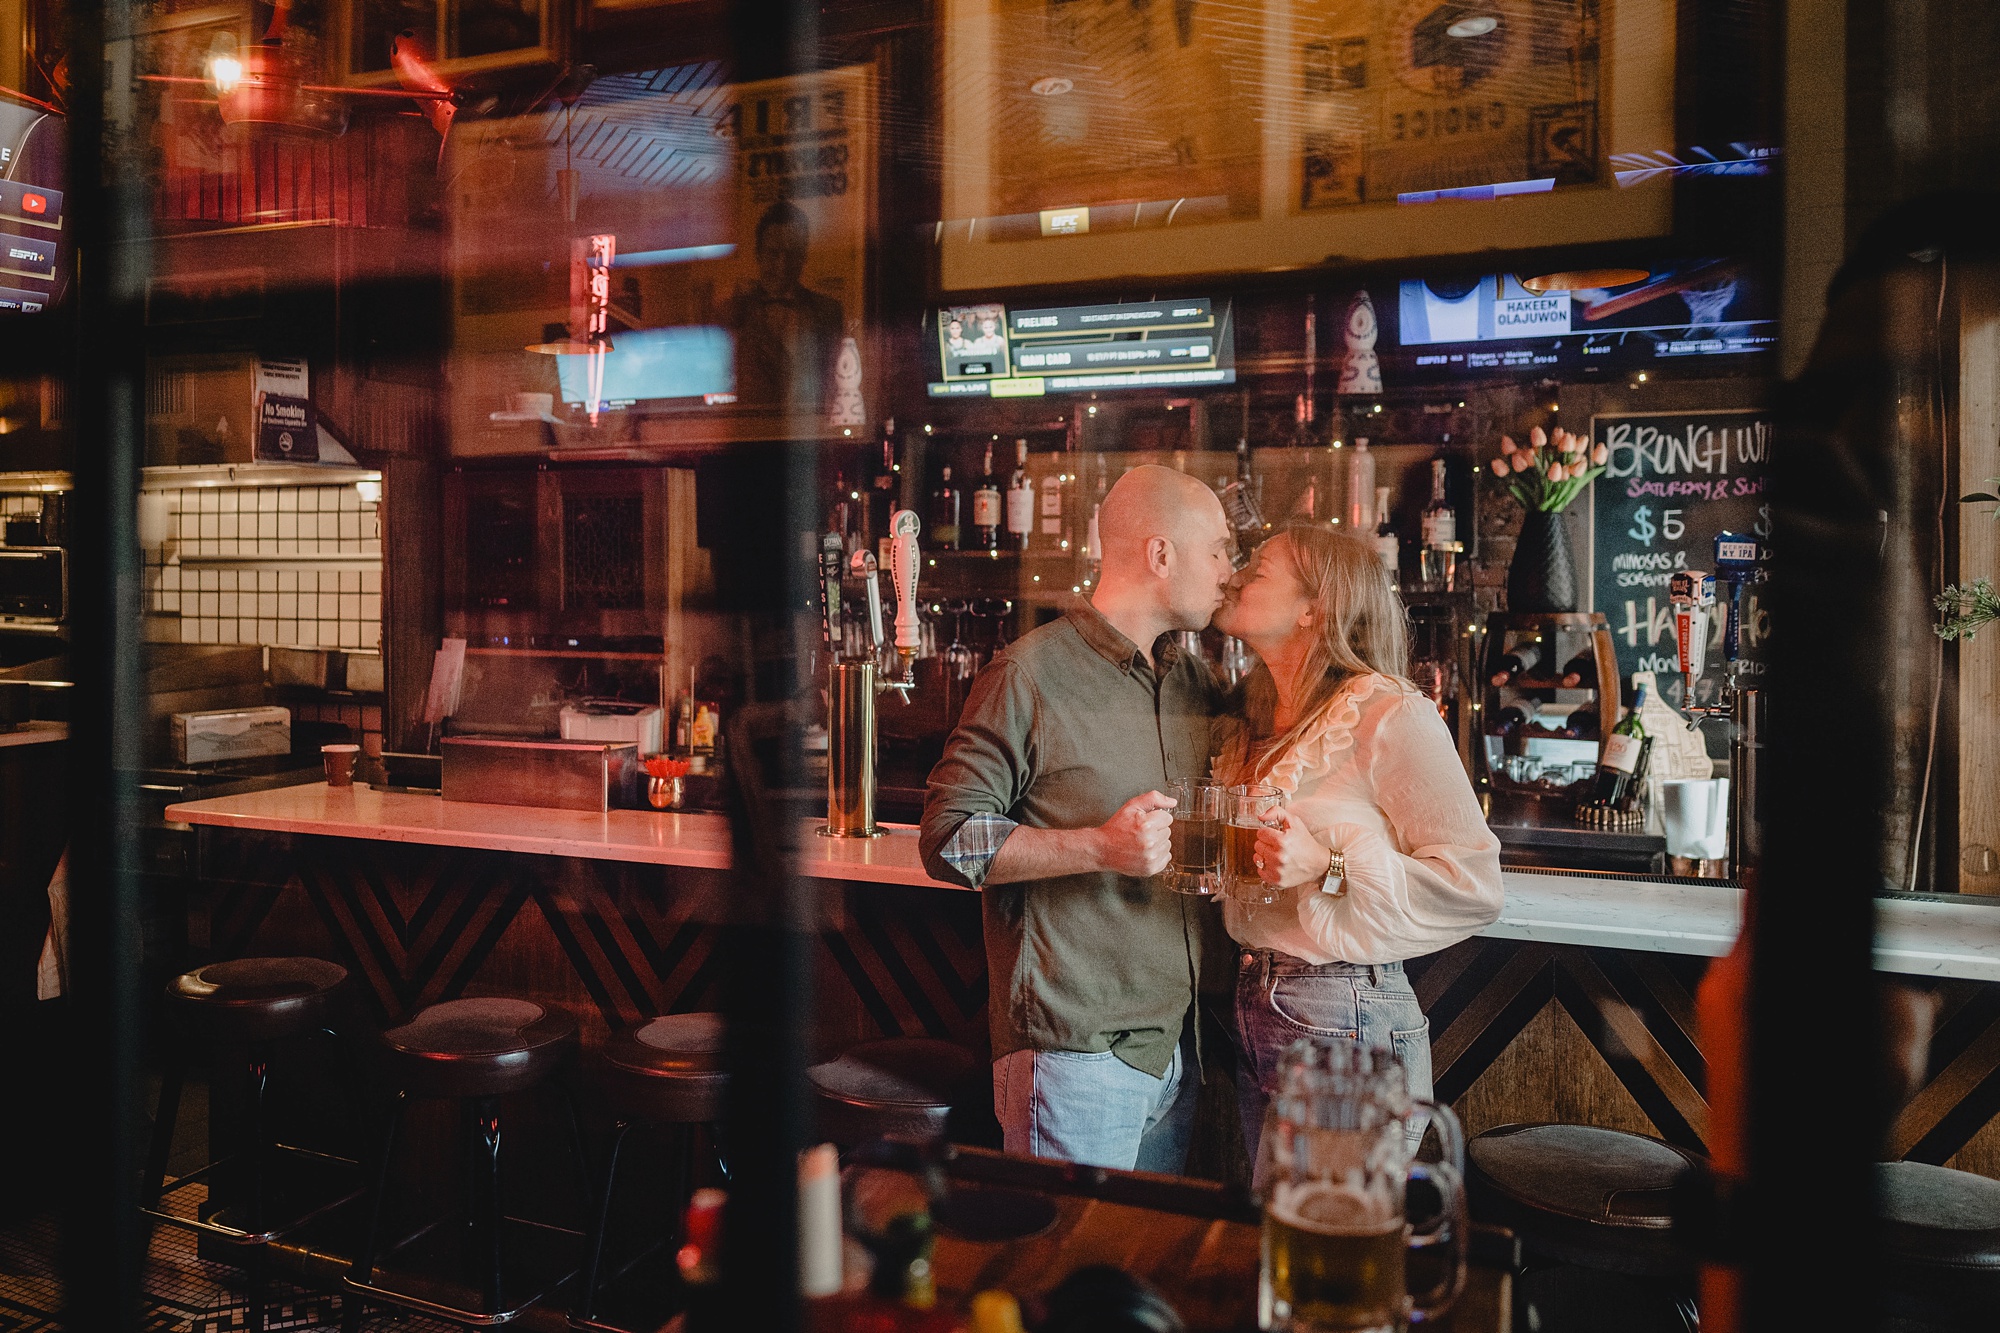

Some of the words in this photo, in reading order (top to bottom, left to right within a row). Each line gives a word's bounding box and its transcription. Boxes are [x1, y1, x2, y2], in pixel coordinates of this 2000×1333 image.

[1051, 215, 1079, 227] UFC
[1507, 300, 1558, 312] HAKEEM
[1498, 311, 1567, 325] OLAJUWON
[265, 403, 275, 416] No
[276, 403, 306, 421] Smoking
[1605, 424, 1728, 478] BRUNCH
[1627, 478, 1712, 500] SATURDAY
[1712, 479, 1729, 500] &
[1613, 552, 1673, 572] MIMOSAS
[1739, 550, 1752, 558] IPA
[818, 553, 829, 642] ELYSIAN
